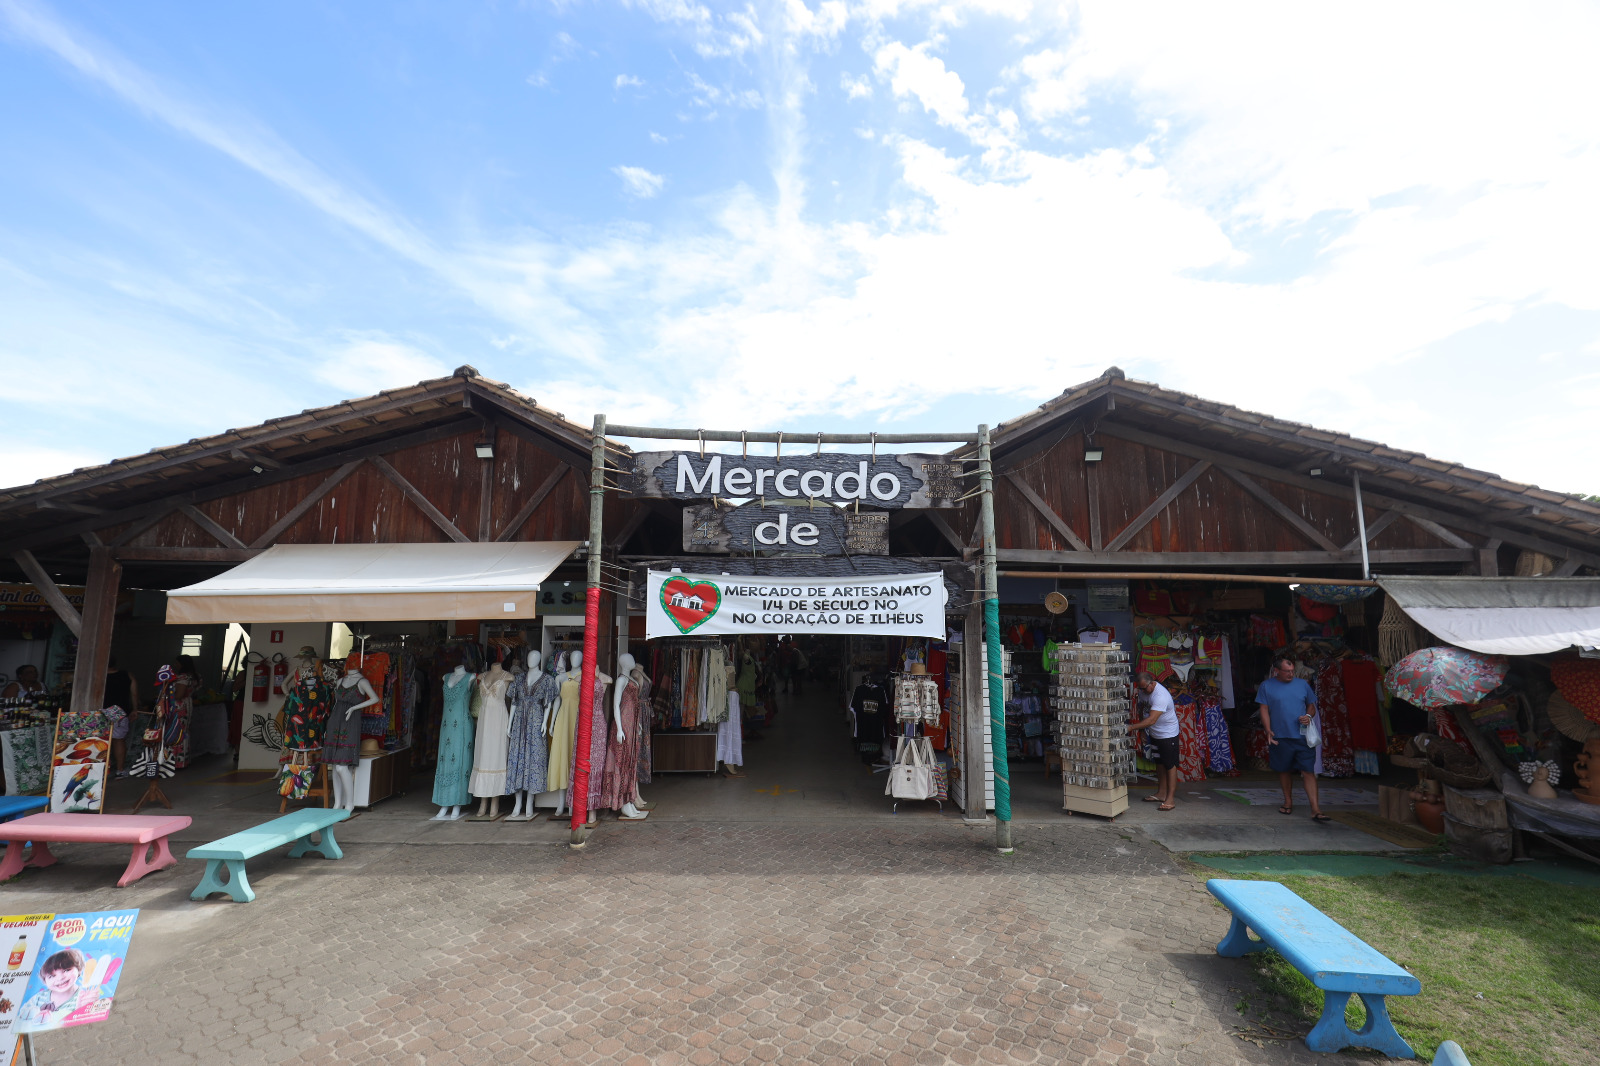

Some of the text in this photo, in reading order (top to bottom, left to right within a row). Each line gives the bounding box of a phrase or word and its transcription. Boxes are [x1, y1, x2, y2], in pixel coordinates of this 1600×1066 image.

[675, 454, 901, 500] Mercado
[754, 513, 820, 546] de
[724, 585, 932, 597] MERCADO DE ARTESANATO
[788, 600, 808, 610] DE
[813, 598, 869, 611] SÉCULO
[874, 599, 899, 611] NO
[732, 611, 924, 626] NO CORAÇÃO DE ILHÉUS
[90, 914, 135, 929] AQUI
[89, 926, 132, 941] TEM!
